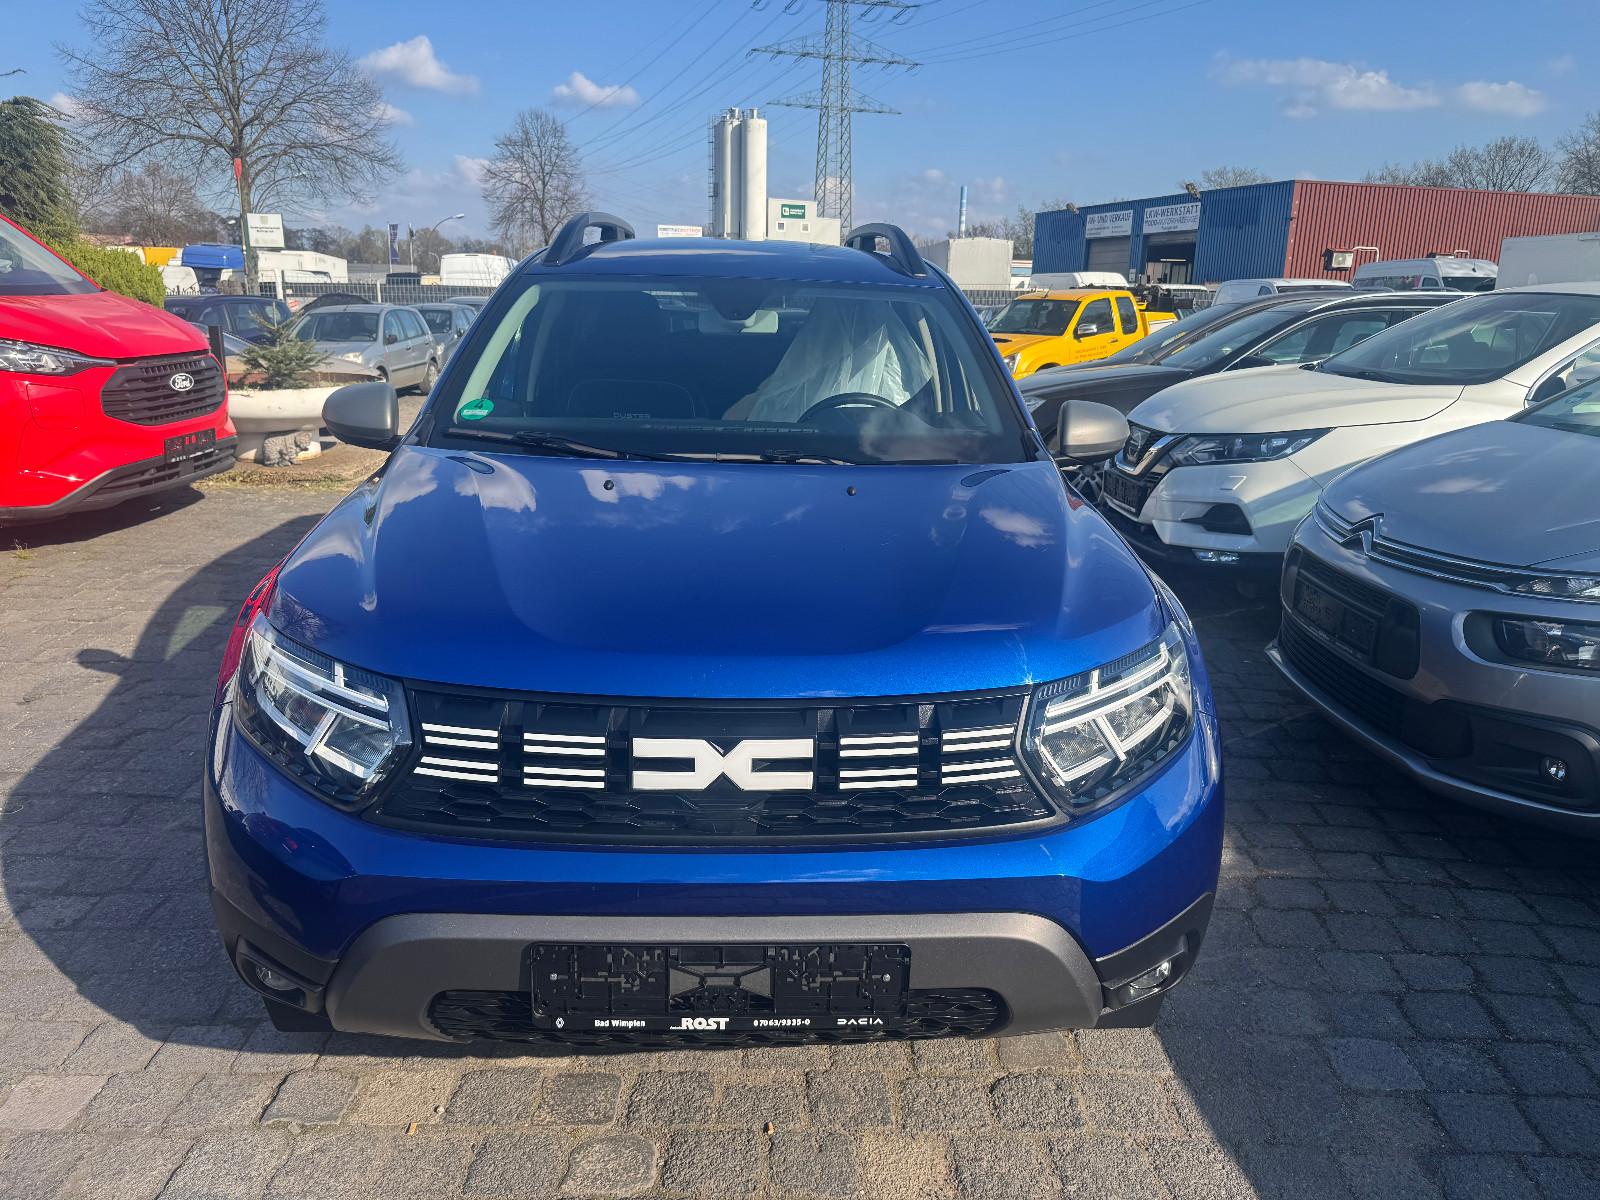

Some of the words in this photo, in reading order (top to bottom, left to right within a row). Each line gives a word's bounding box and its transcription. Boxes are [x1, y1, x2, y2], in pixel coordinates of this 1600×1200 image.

[1145, 204, 1200, 219] LKW-WERKSTATT
[594, 1019, 610, 1027] Bad
[611, 1019, 646, 1029] Wimpfen
[681, 1017, 730, 1030] ROST
